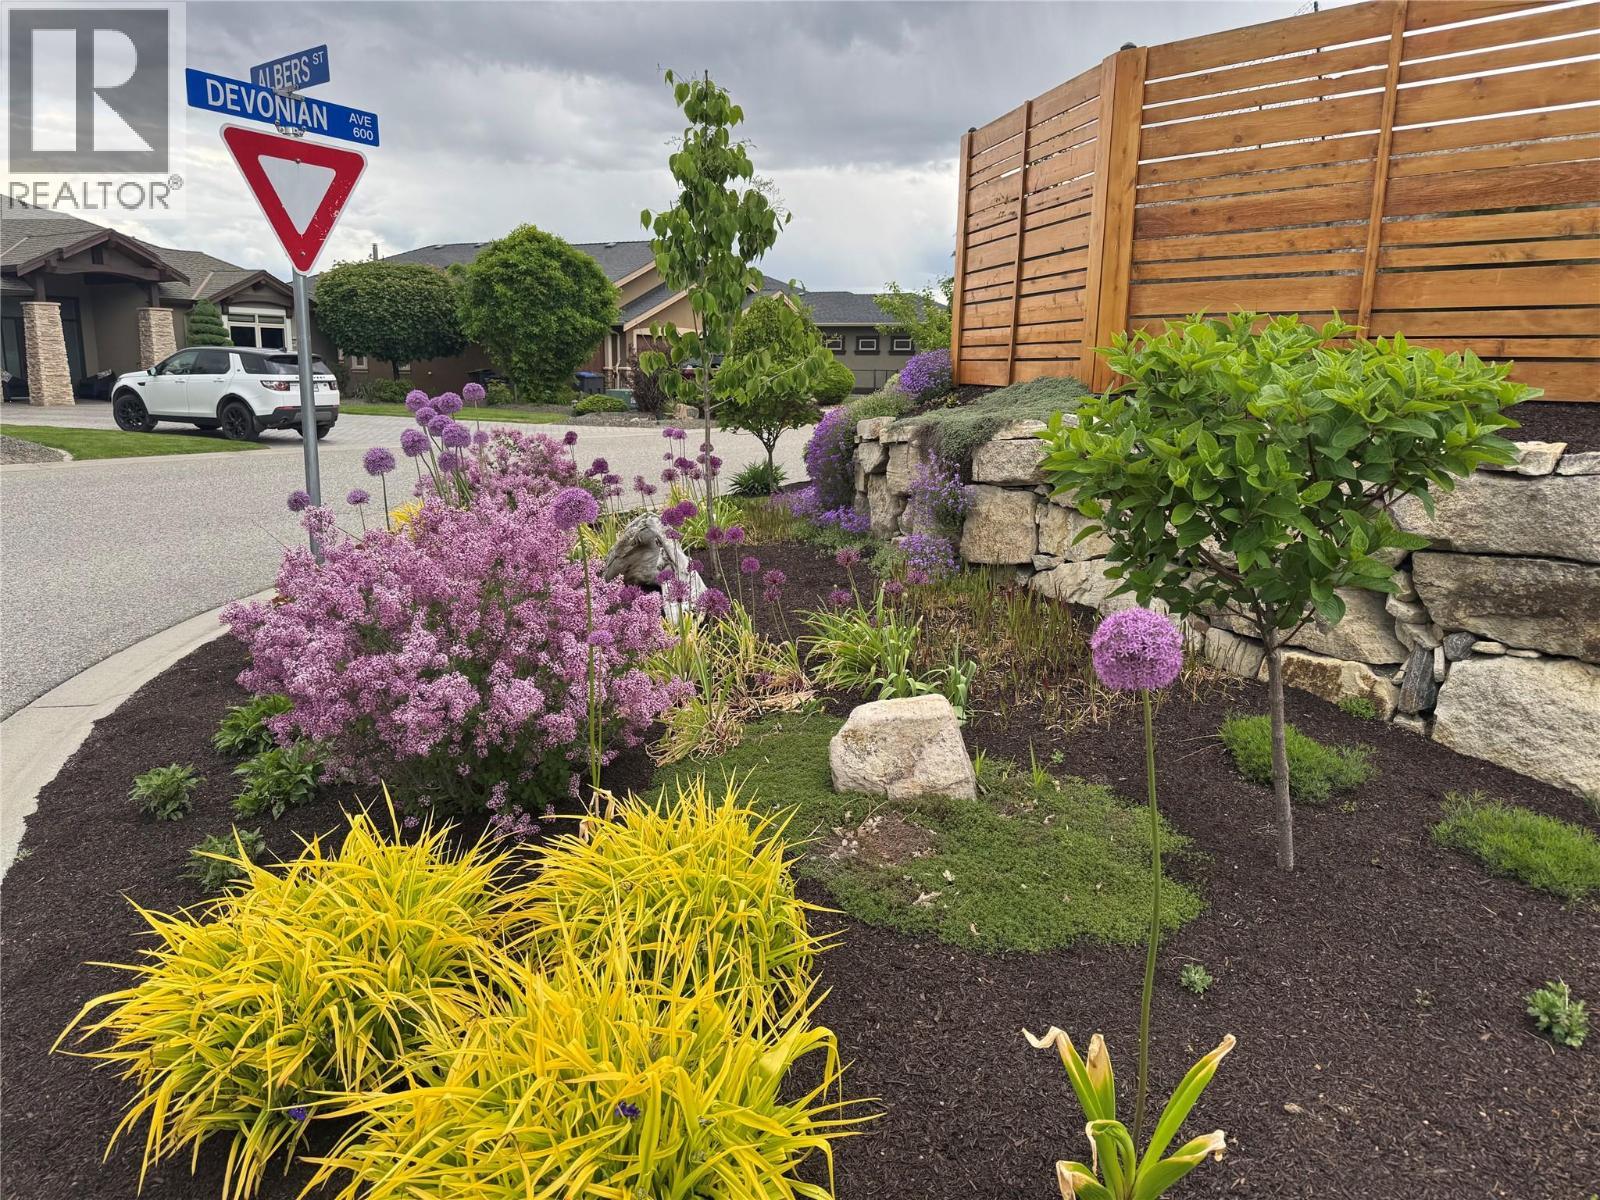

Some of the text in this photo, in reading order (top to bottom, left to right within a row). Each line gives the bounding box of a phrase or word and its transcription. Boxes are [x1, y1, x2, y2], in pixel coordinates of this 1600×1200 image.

[258, 51, 324, 90] ALBERS ST
[205, 78, 372, 131] DEVONIAN AVE
[352, 127, 374, 141] 600
